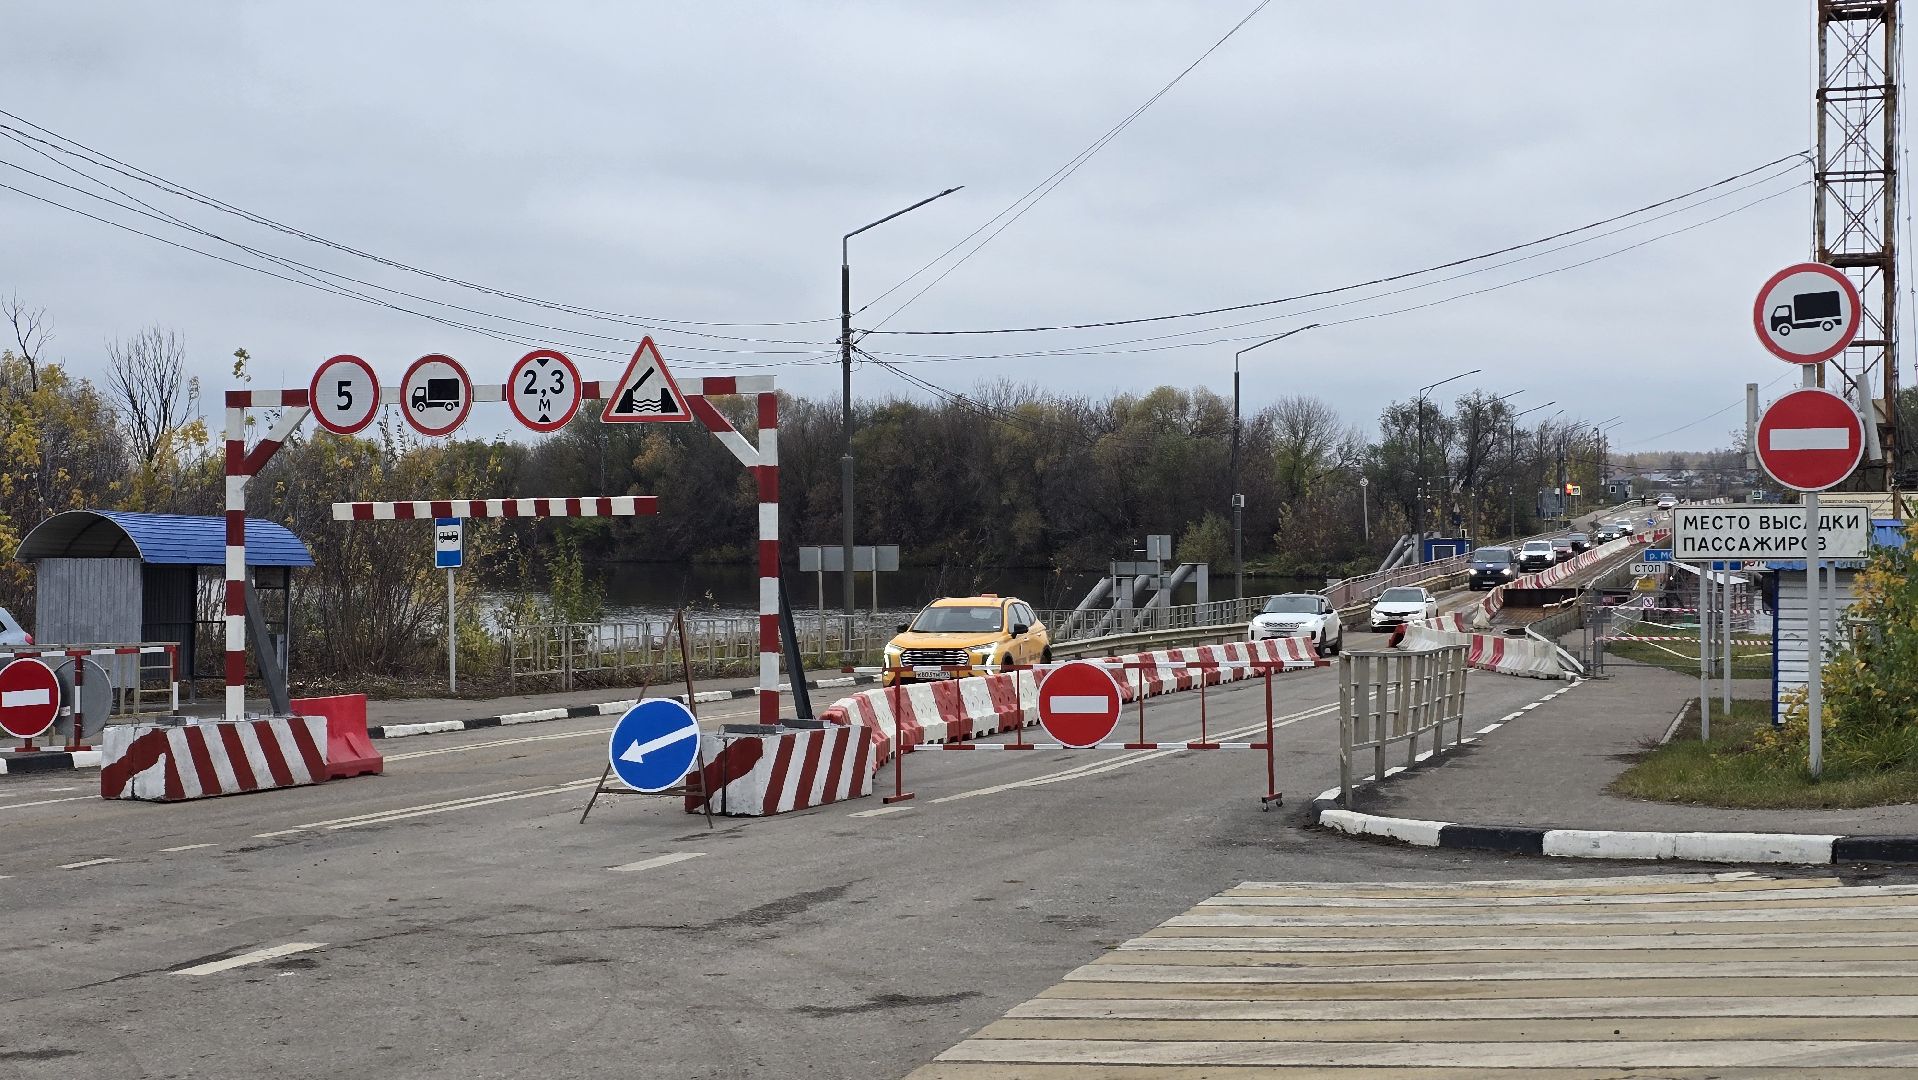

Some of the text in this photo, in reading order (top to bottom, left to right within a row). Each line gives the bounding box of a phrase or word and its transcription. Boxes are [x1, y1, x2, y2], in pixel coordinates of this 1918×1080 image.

[523, 369, 565, 397] 2,3
[336, 380, 353, 411] 5
[1683, 515, 1859, 532] МЕСТО ВЫСДКИ
[1634, 564, 1661, 573] СТОП
